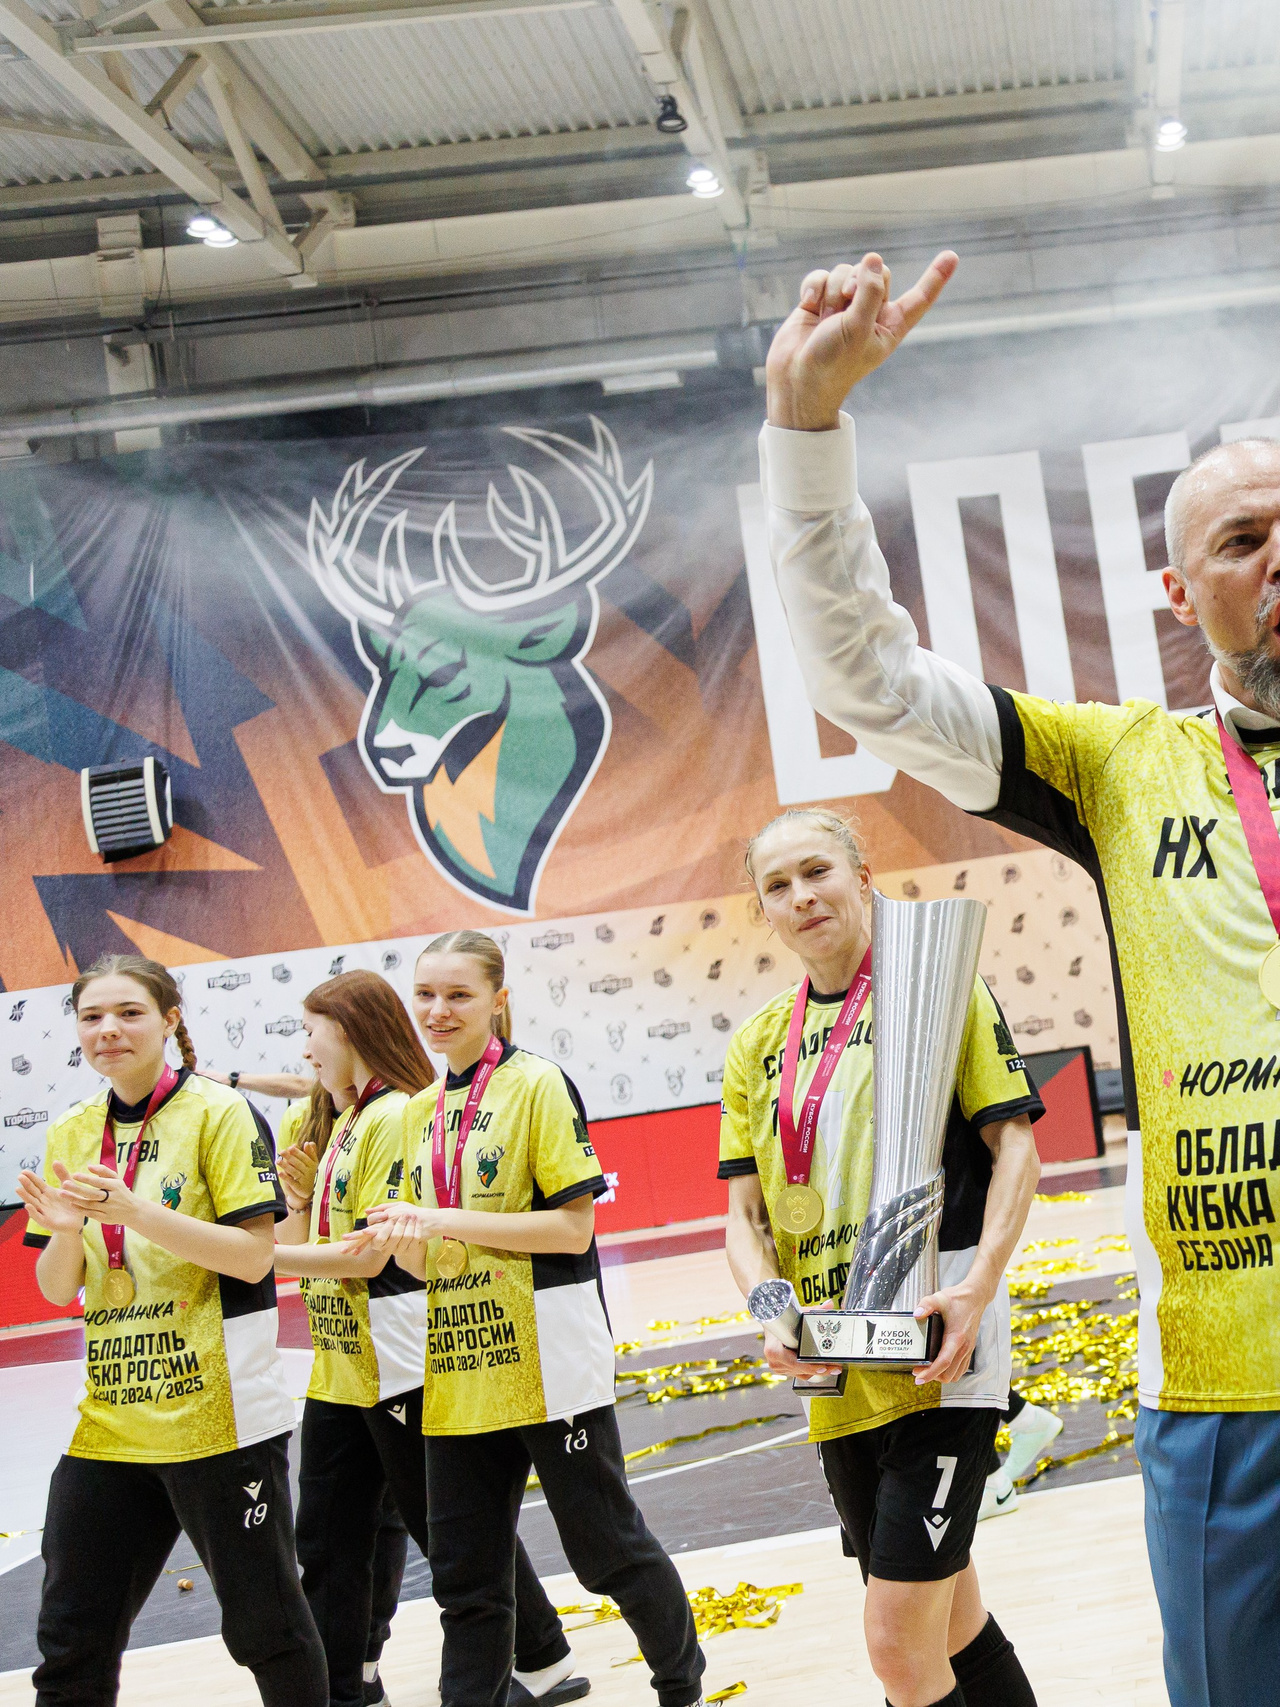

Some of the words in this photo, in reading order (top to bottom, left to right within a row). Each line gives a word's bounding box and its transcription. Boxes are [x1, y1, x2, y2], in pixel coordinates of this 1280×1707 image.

[1152, 815, 1218, 879] НХ
[5, 1110, 48, 1127] ТОРПЕДО
[802, 1126, 813, 1153] РОССИИ
[1166, 1178, 1276, 1232] КУБКА
[1177, 1229, 1273, 1272] СЕЗОНА
[881, 1330, 910, 1338] КУБОК
[244, 1503, 269, 1529] 19
